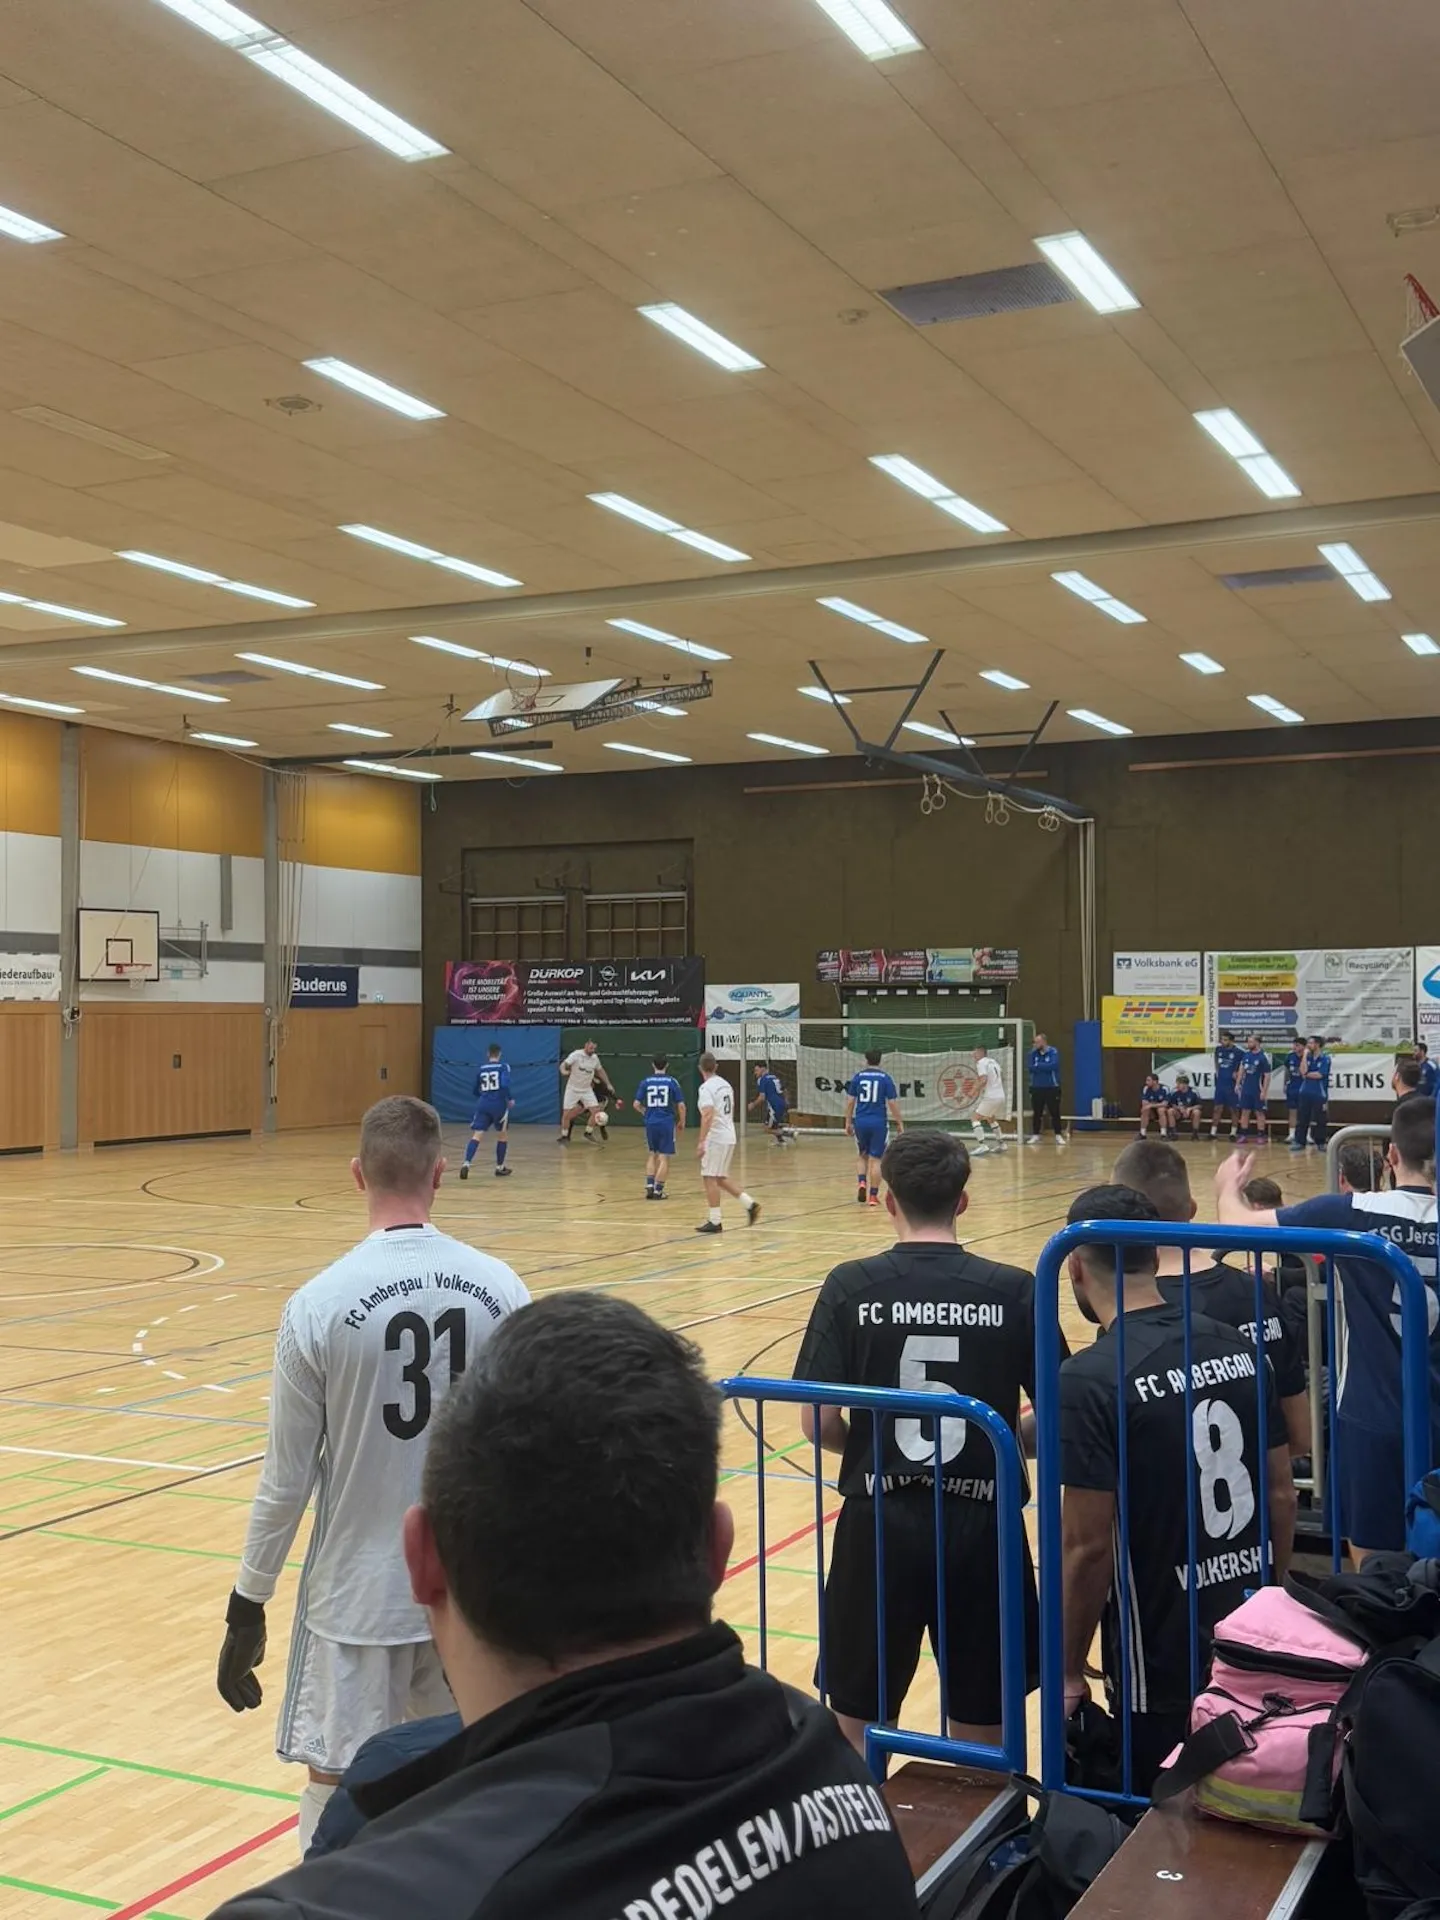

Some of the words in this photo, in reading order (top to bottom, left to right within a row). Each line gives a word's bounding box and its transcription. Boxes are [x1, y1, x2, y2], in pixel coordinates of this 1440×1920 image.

[1134, 957, 1183, 968] Volksbank
[1185, 958, 1198, 968] eG
[292, 977, 347, 992] Buderus
[730, 990, 772, 998] AQUANTIC
[480, 1071, 500, 1091] 33
[815, 1076, 926, 1099] exrt
[859, 1080, 879, 1103] 31
[1327, 1072, 1385, 1089] ELTINS
[647, 1085, 669, 1107] 23
[1406, 1226, 1440, 1246] Jers
[344, 1309, 366, 1330] FC
[359, 1276, 423, 1313] Ambergau
[434, 1271, 502, 1320] Volkersheim
[858, 1302, 884, 1326] FC
[891, 1301, 1004, 1327] AMBERGAU
[383, 1307, 466, 1441] 31
[1134, 1374, 1166, 1403] FC
[895, 1335, 966, 1466] 5
[1192, 1398, 1255, 1540] 8
